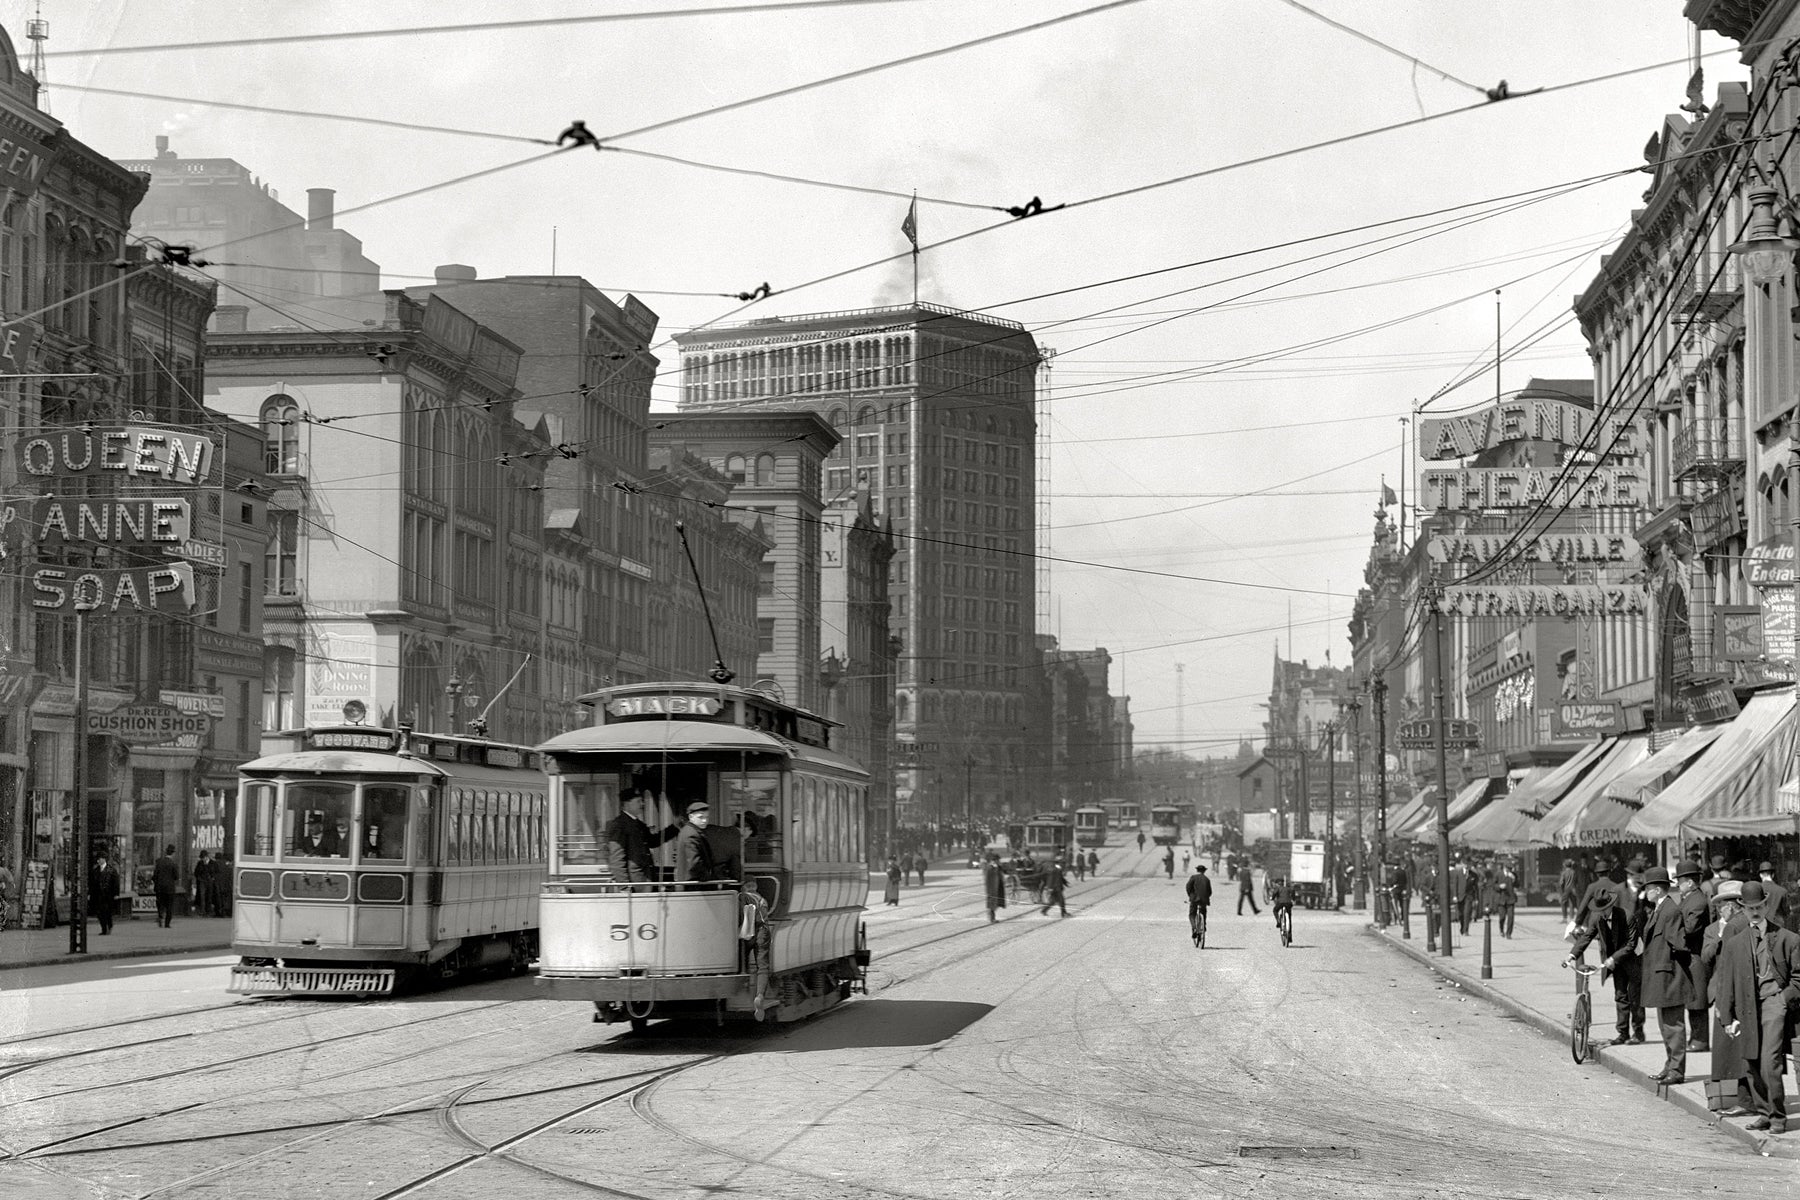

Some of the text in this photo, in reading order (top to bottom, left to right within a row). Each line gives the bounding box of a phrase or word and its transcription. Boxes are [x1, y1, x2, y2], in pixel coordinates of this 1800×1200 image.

[1431, 401, 1638, 460] AVENUE
[24, 431, 203, 478] QUEEN
[1427, 470, 1640, 508] THEATRE
[40, 502, 182, 541] ANNE
[1438, 537, 1626, 562] VAUDEVILLE
[33, 569, 182, 612] SOAP
[323, 669, 369, 684] DINING
[618, 697, 713, 715] MACK
[1562, 705, 1614, 724] OLYMPIA
[89, 717, 205, 731] CUSHION SHOE
[1402, 721, 1478, 738] HOEL
[1579, 827, 1621, 842] CREAM
[609, 922, 659, 942] 56
